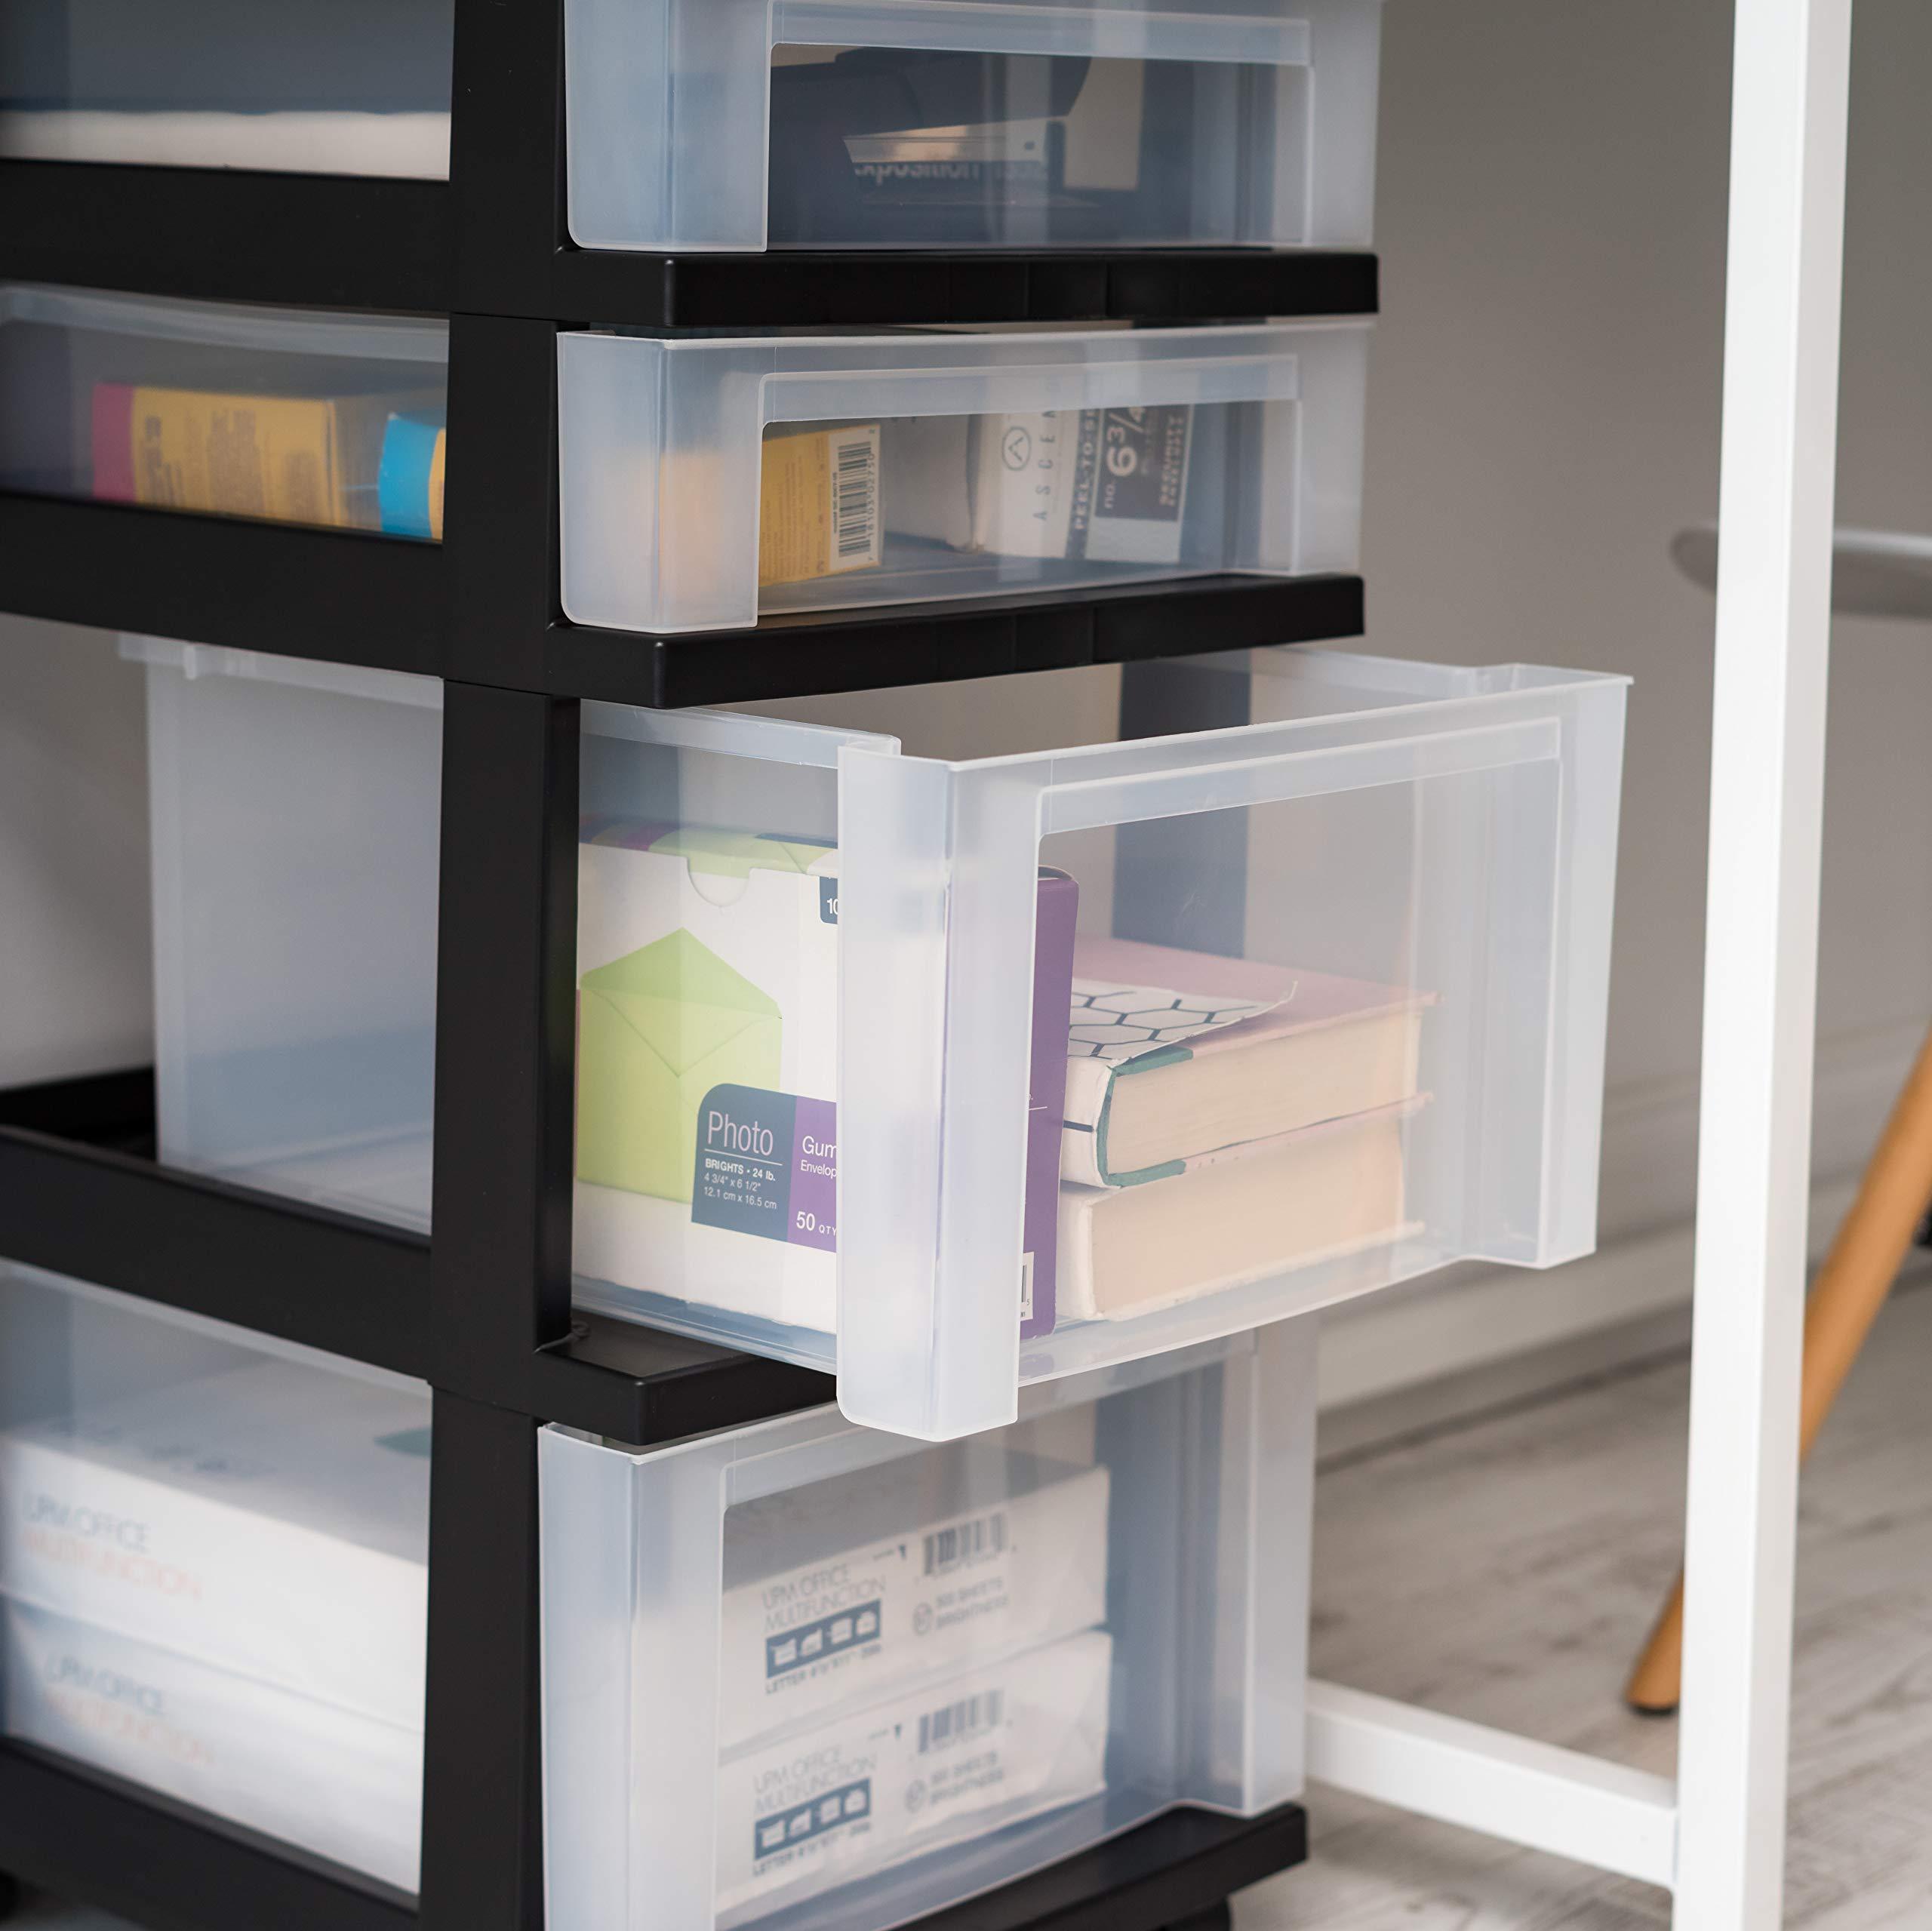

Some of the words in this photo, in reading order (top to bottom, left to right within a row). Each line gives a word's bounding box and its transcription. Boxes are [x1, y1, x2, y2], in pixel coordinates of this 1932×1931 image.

[708, 1111, 774, 1156] Photo
[704, 1173, 710, 1181] 4
[737, 1179, 742, 1188] 6
[705, 1158, 744, 1174] BRIGHTS
[752, 1168, 763, 1178] 24
[765, 1170, 776, 1181] lb.
[704, 1186, 721, 1198] 12.1
[724, 1192, 736, 1201] cm
[746, 1195, 762, 1207] 16.5
[764, 1200, 777, 1209] cm
[796, 1211, 816, 1231] 50
[819, 1224, 836, 1236] QTY
[761, 1582, 797, 1610] UPM
[800, 1564, 849, 1596] OFFICE
[765, 1575, 887, 1631] MULTIFUNCTION
[753, 1765, 789, 1793] UPM
[792, 1745, 841, 1778] OFFICE
